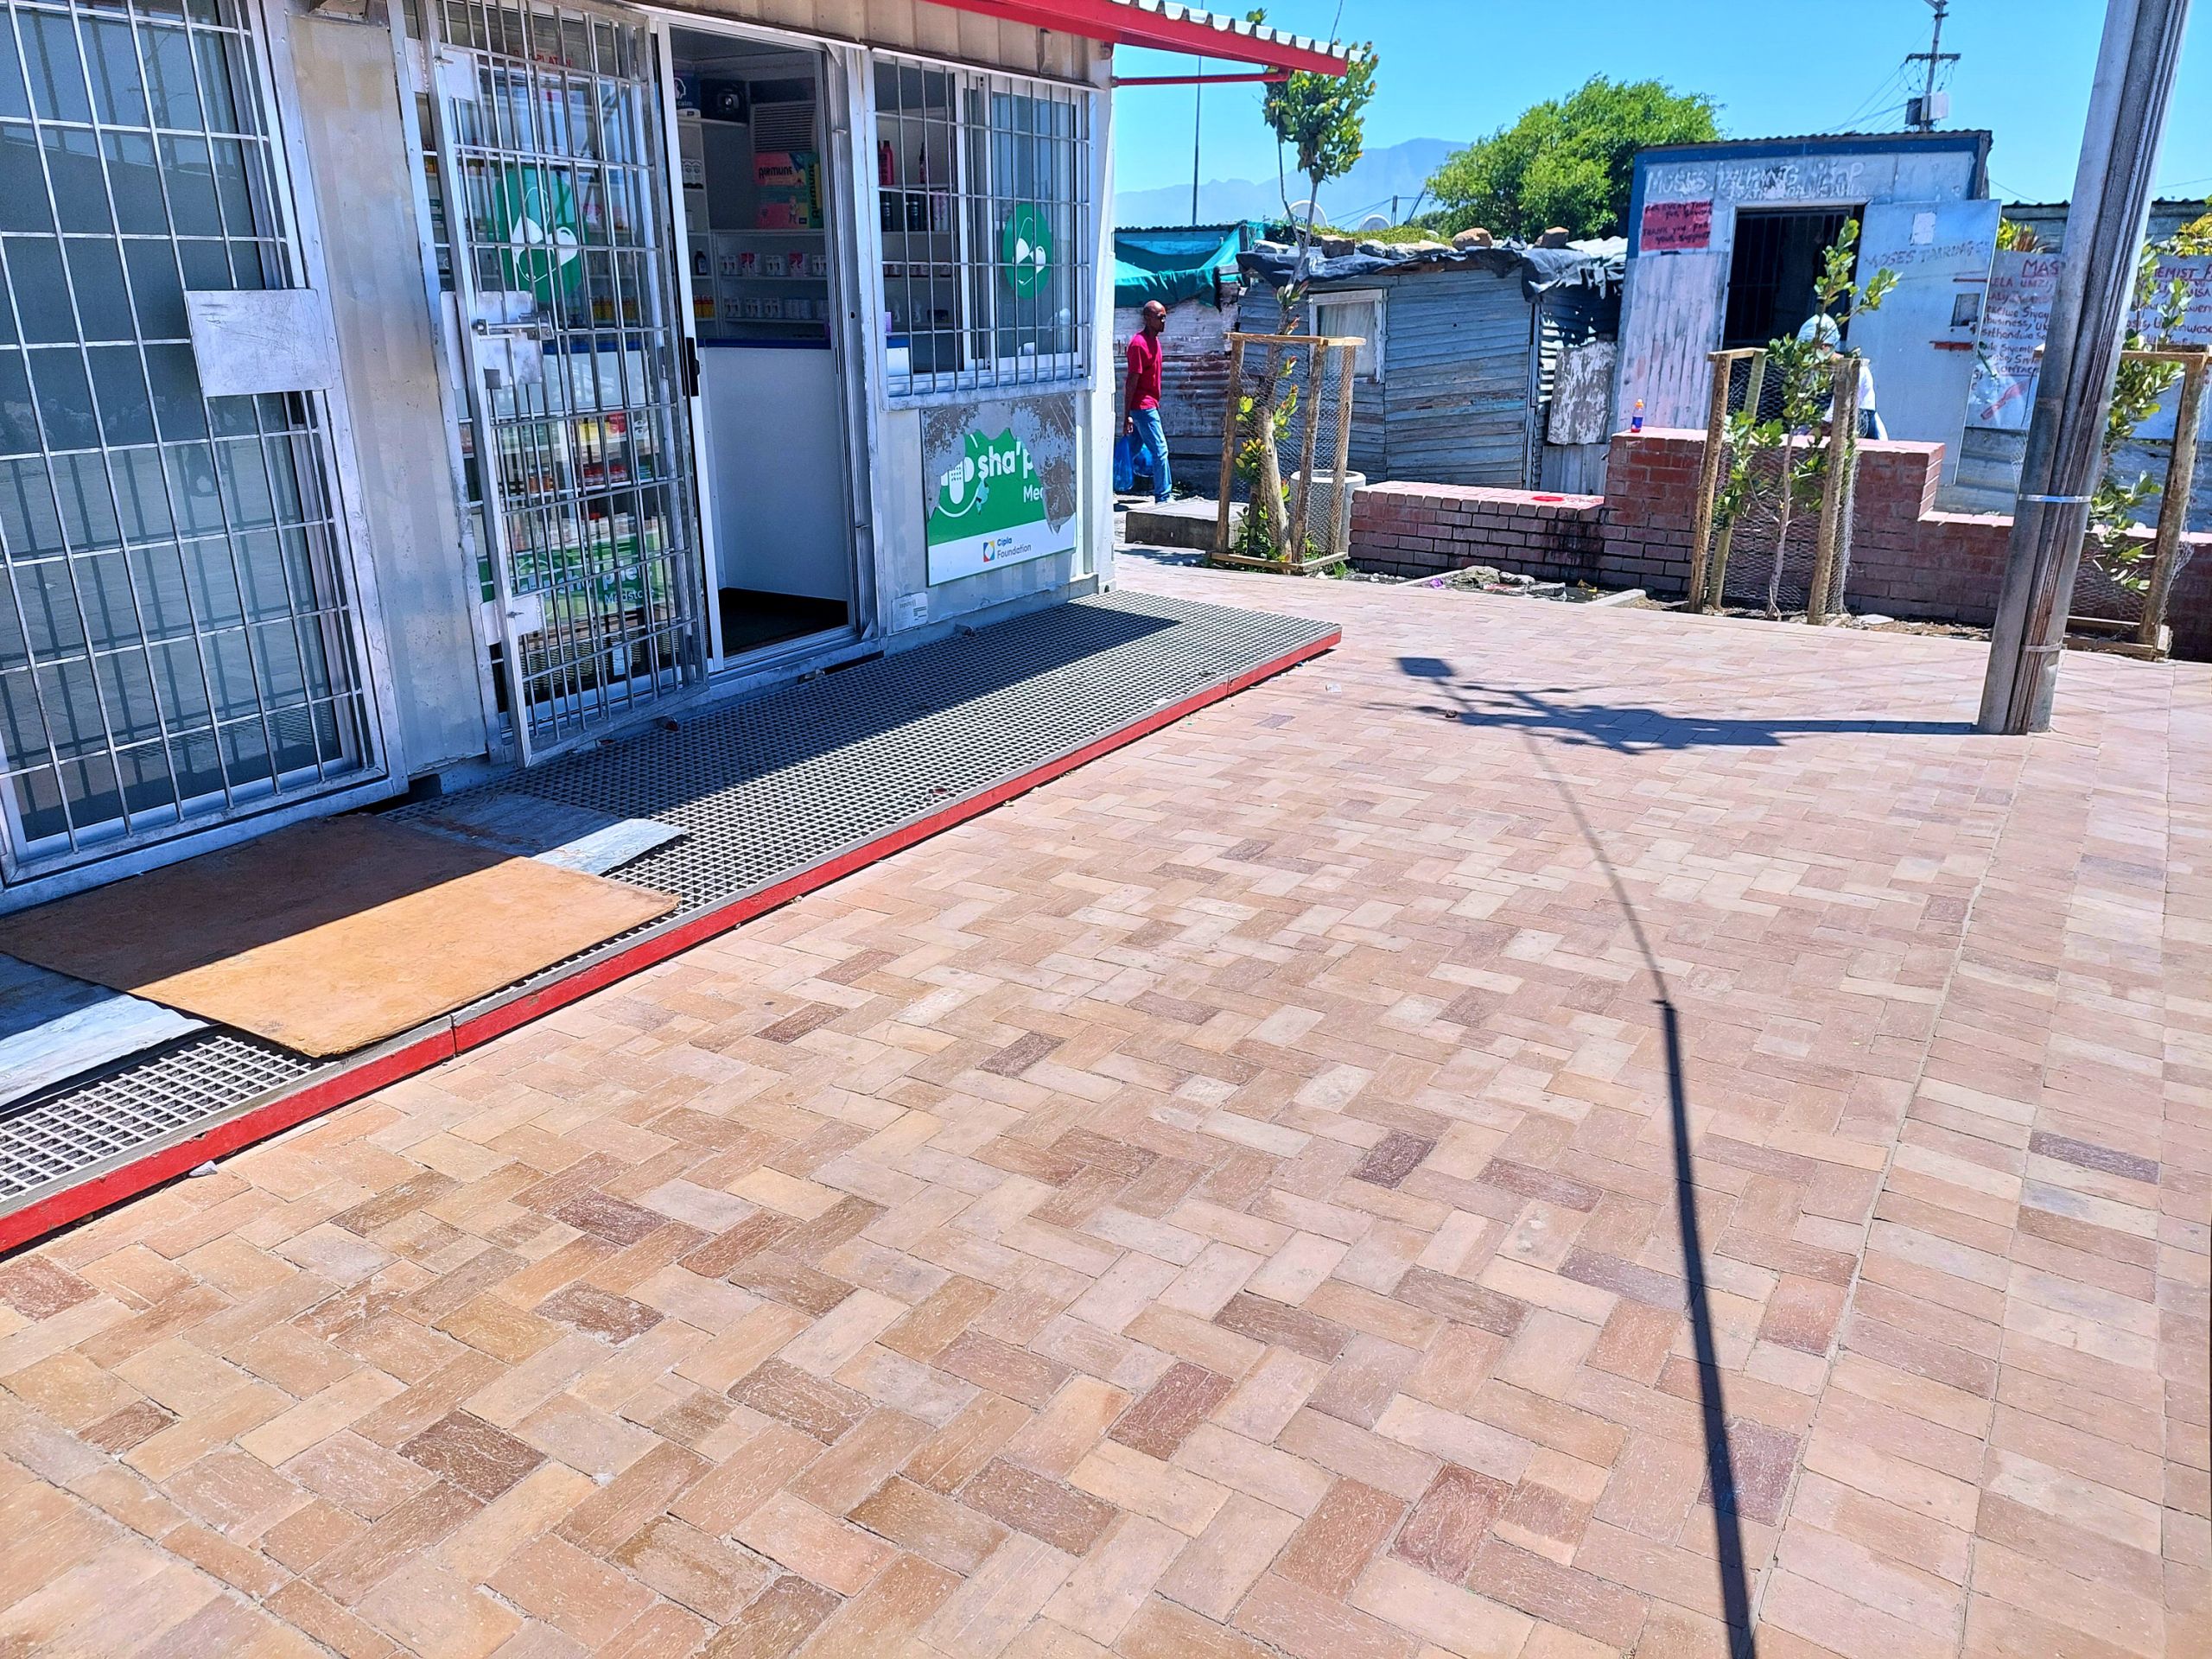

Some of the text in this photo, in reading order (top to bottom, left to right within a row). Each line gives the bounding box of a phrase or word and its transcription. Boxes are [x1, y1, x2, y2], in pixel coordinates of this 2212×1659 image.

[759, 166, 792, 179] AIRMUNE
[996, 536, 1013, 547] Cipla
[996, 543, 1032, 558] Foundation
